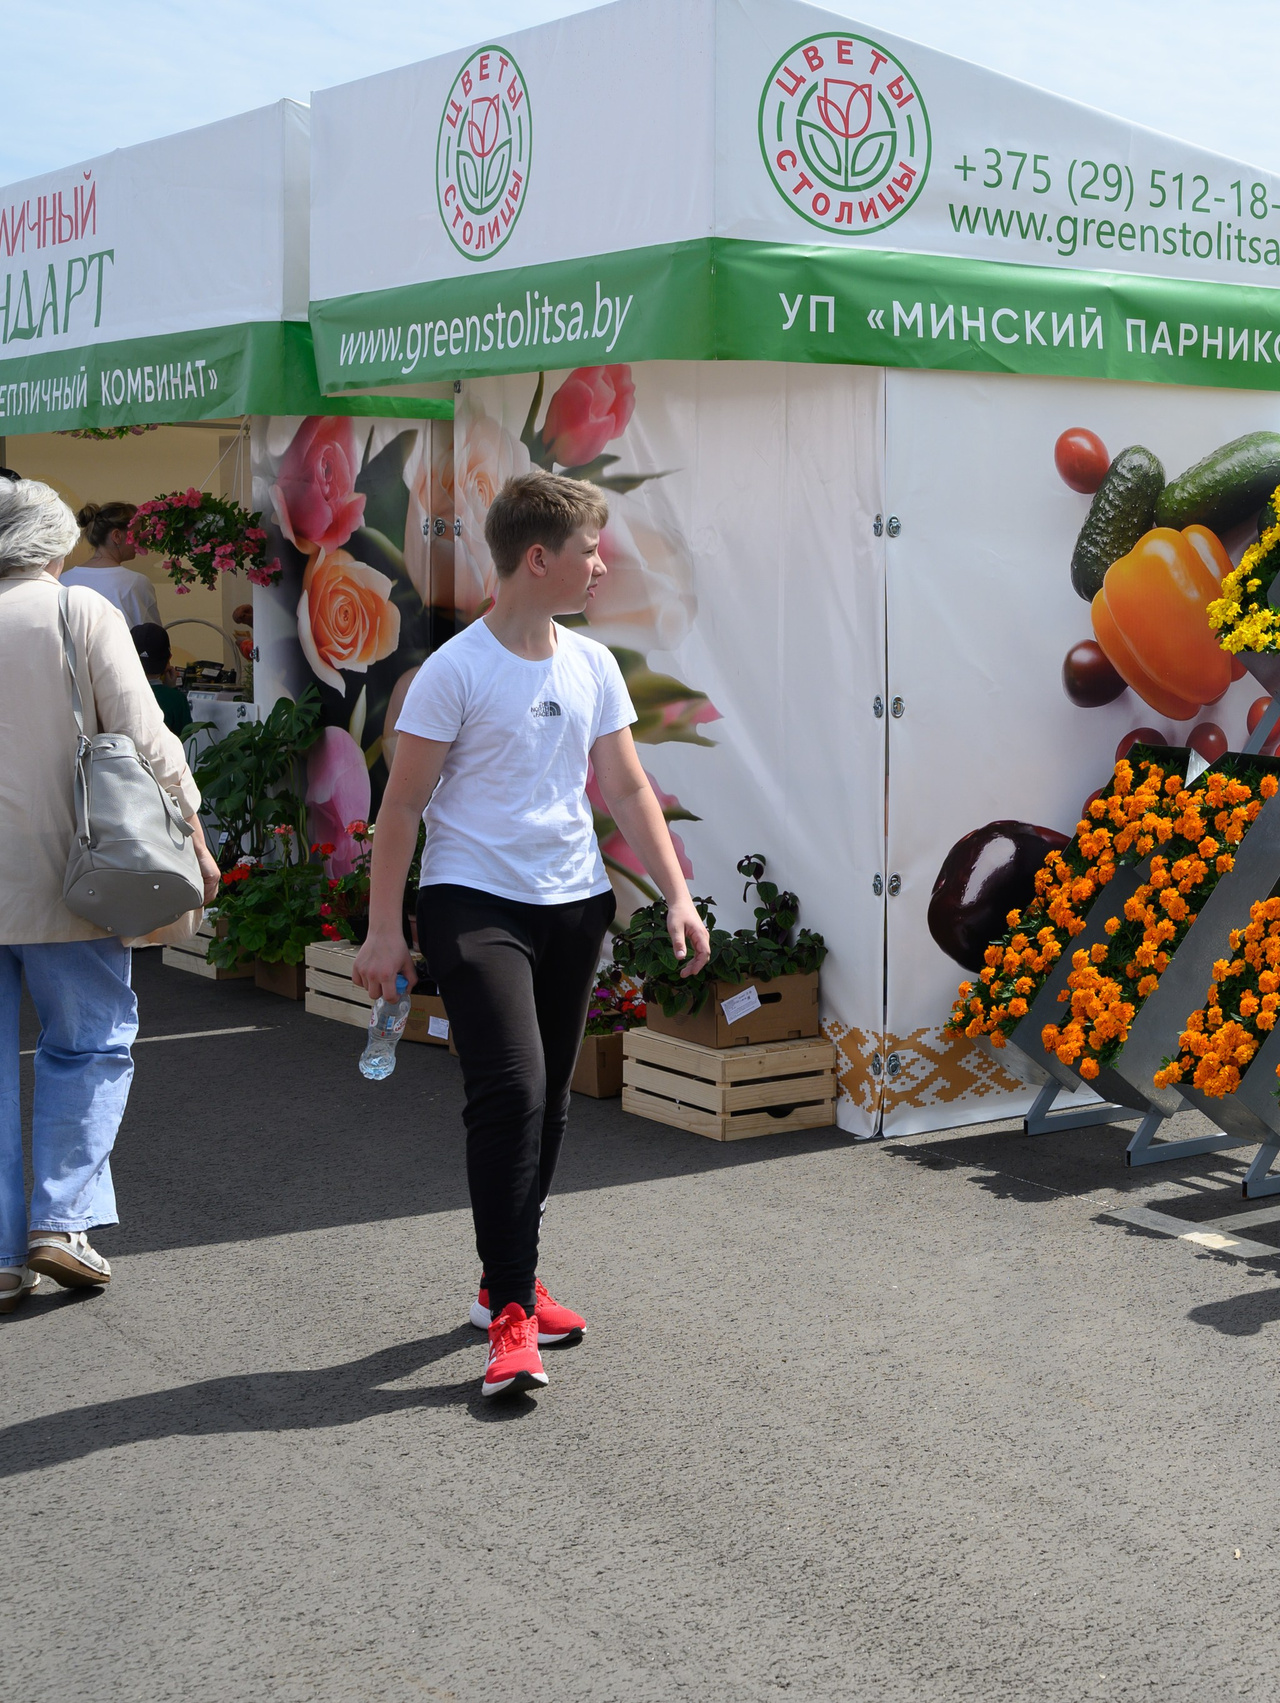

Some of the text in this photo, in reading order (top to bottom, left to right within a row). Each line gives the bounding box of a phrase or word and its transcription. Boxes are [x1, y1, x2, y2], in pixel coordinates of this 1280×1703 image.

[446, 54, 525, 129] ЦВЕТЫ
[774, 40, 914, 110] ЦВЕТЫ
[443, 169, 523, 251] СТОЛИЦЫ
[774, 148, 917, 226] СТОЛИЦЫ
[953, 148, 1053, 194] +375
[1067, 159, 1135, 212] (29)
[339, 281, 634, 375] www.greenstolitsa.by
[778, 293, 835, 334] УП
[867, 299, 1104, 351] «МИНСКИЙ
[100, 359, 218, 407] КОМБИНАТ»
